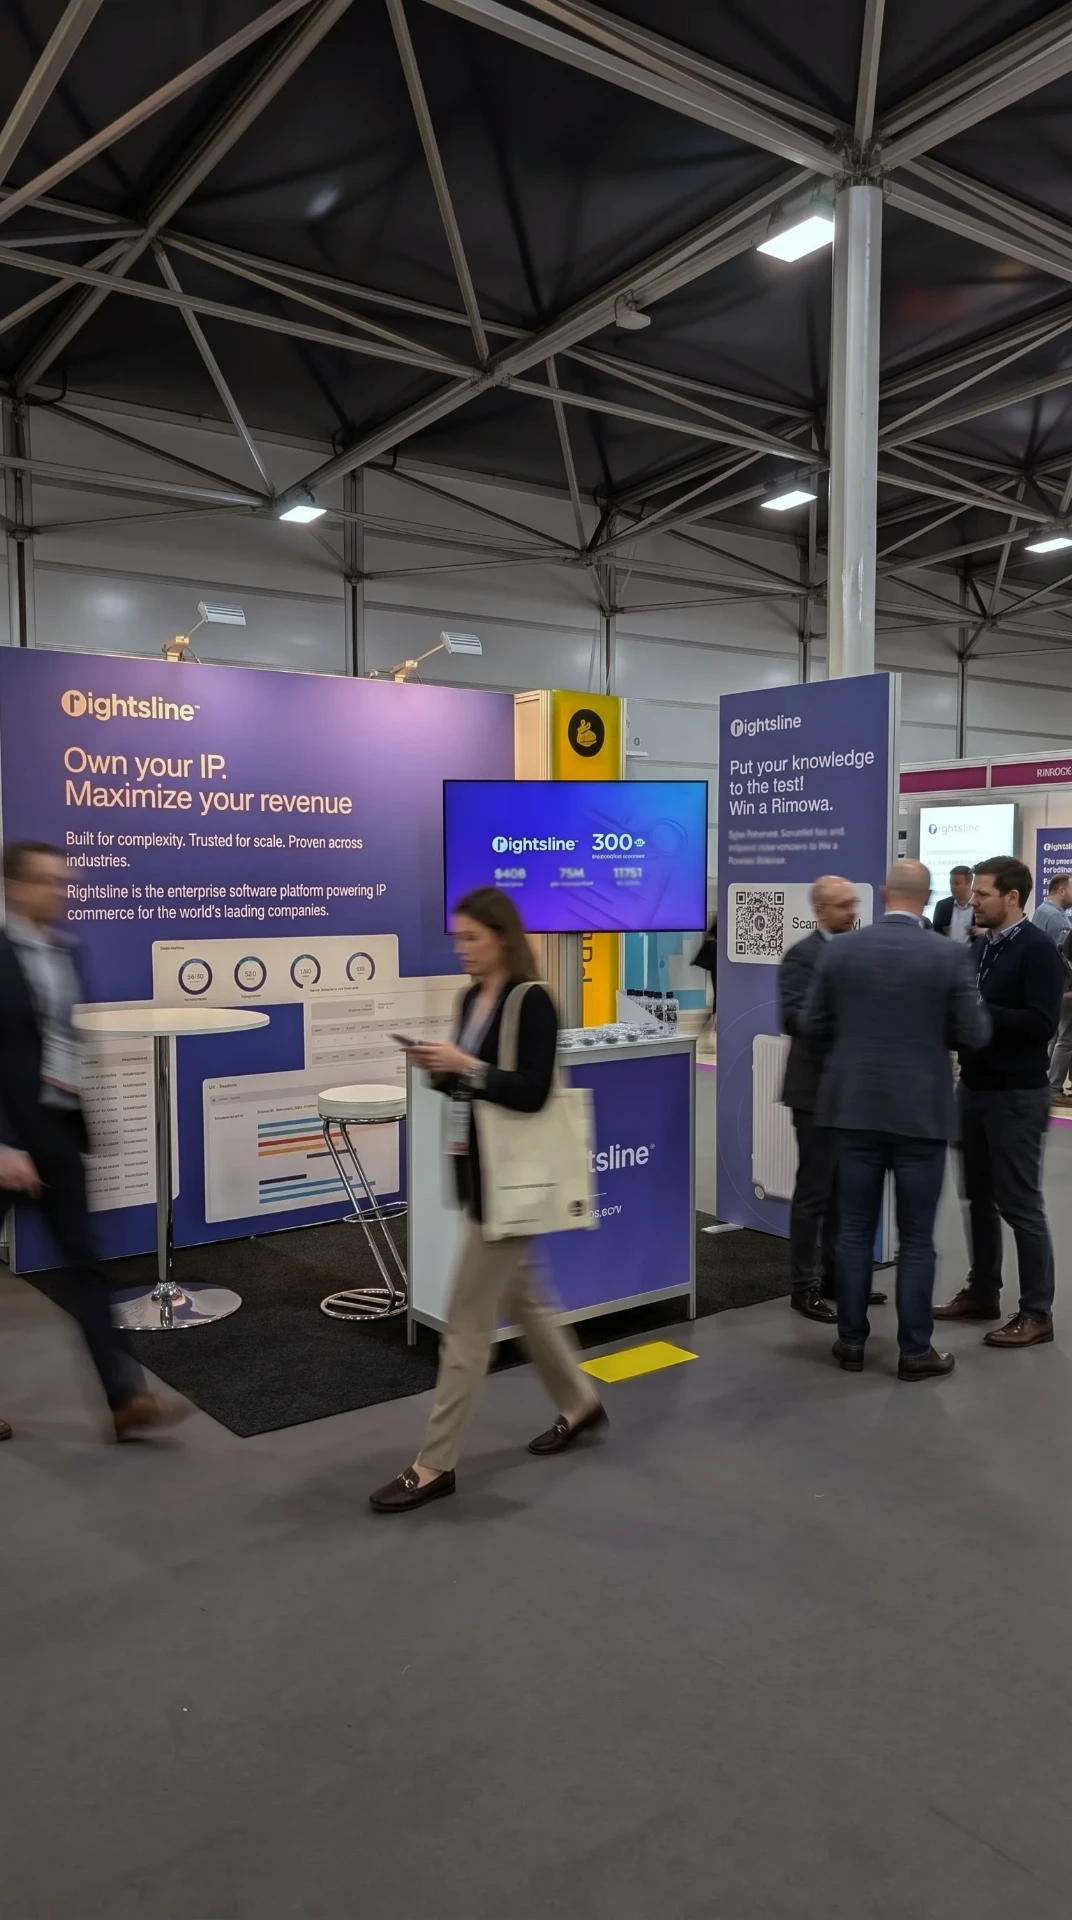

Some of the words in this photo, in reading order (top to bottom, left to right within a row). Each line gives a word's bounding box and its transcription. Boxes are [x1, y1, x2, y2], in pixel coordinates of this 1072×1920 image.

[730, 714, 802, 737] rightsline
[64, 746, 128, 775] Own
[134, 756, 194, 781] your
[200, 753, 227, 779] IP.
[730, 760, 753, 775] Put
[757, 759, 789, 777] your
[792, 749, 875, 769] knowledge
[729, 781, 743, 795] to
[747, 779, 769, 795] the
[773, 776, 804, 793] test!
[65, 779, 192, 811] Maximize
[198, 791, 255, 816] your
[260, 793, 353, 814] revenue
[729, 800, 755, 816] Win
[758, 802, 768, 814] a
[772, 798, 834, 814] Rimowa.
[66, 831, 95, 846] Built
[97, 831, 115, 846] for
[117, 832, 186, 850] complexity.
[189, 832, 233, 847] Trusted
[235, 833, 251, 848] for
[253, 834, 286, 849] scale.
[288, 835, 326, 849] Proven
[328, 838, 363, 849] across
[592, 833, 633, 851] 300
[66, 853, 131, 867] industries.
[67, 884, 129, 902] Rightsline
[132, 884, 142, 898] is
[145, 884, 165, 898] the
[167, 884, 227, 901] enterprise
[229, 884, 277, 898] software
[280, 884, 324, 900] platform
[326, 883, 374, 900] powering
[376, 884, 387, 896] IP
[67, 907, 135, 920] commerce
[138, 905, 154, 919] for
[157, 905, 177, 919] the
[179, 904, 222, 919] world's
[267, 903, 329, 920] companies.
[792, 916, 818, 930] Scan
[587, 1143, 650, 1173] tsline
